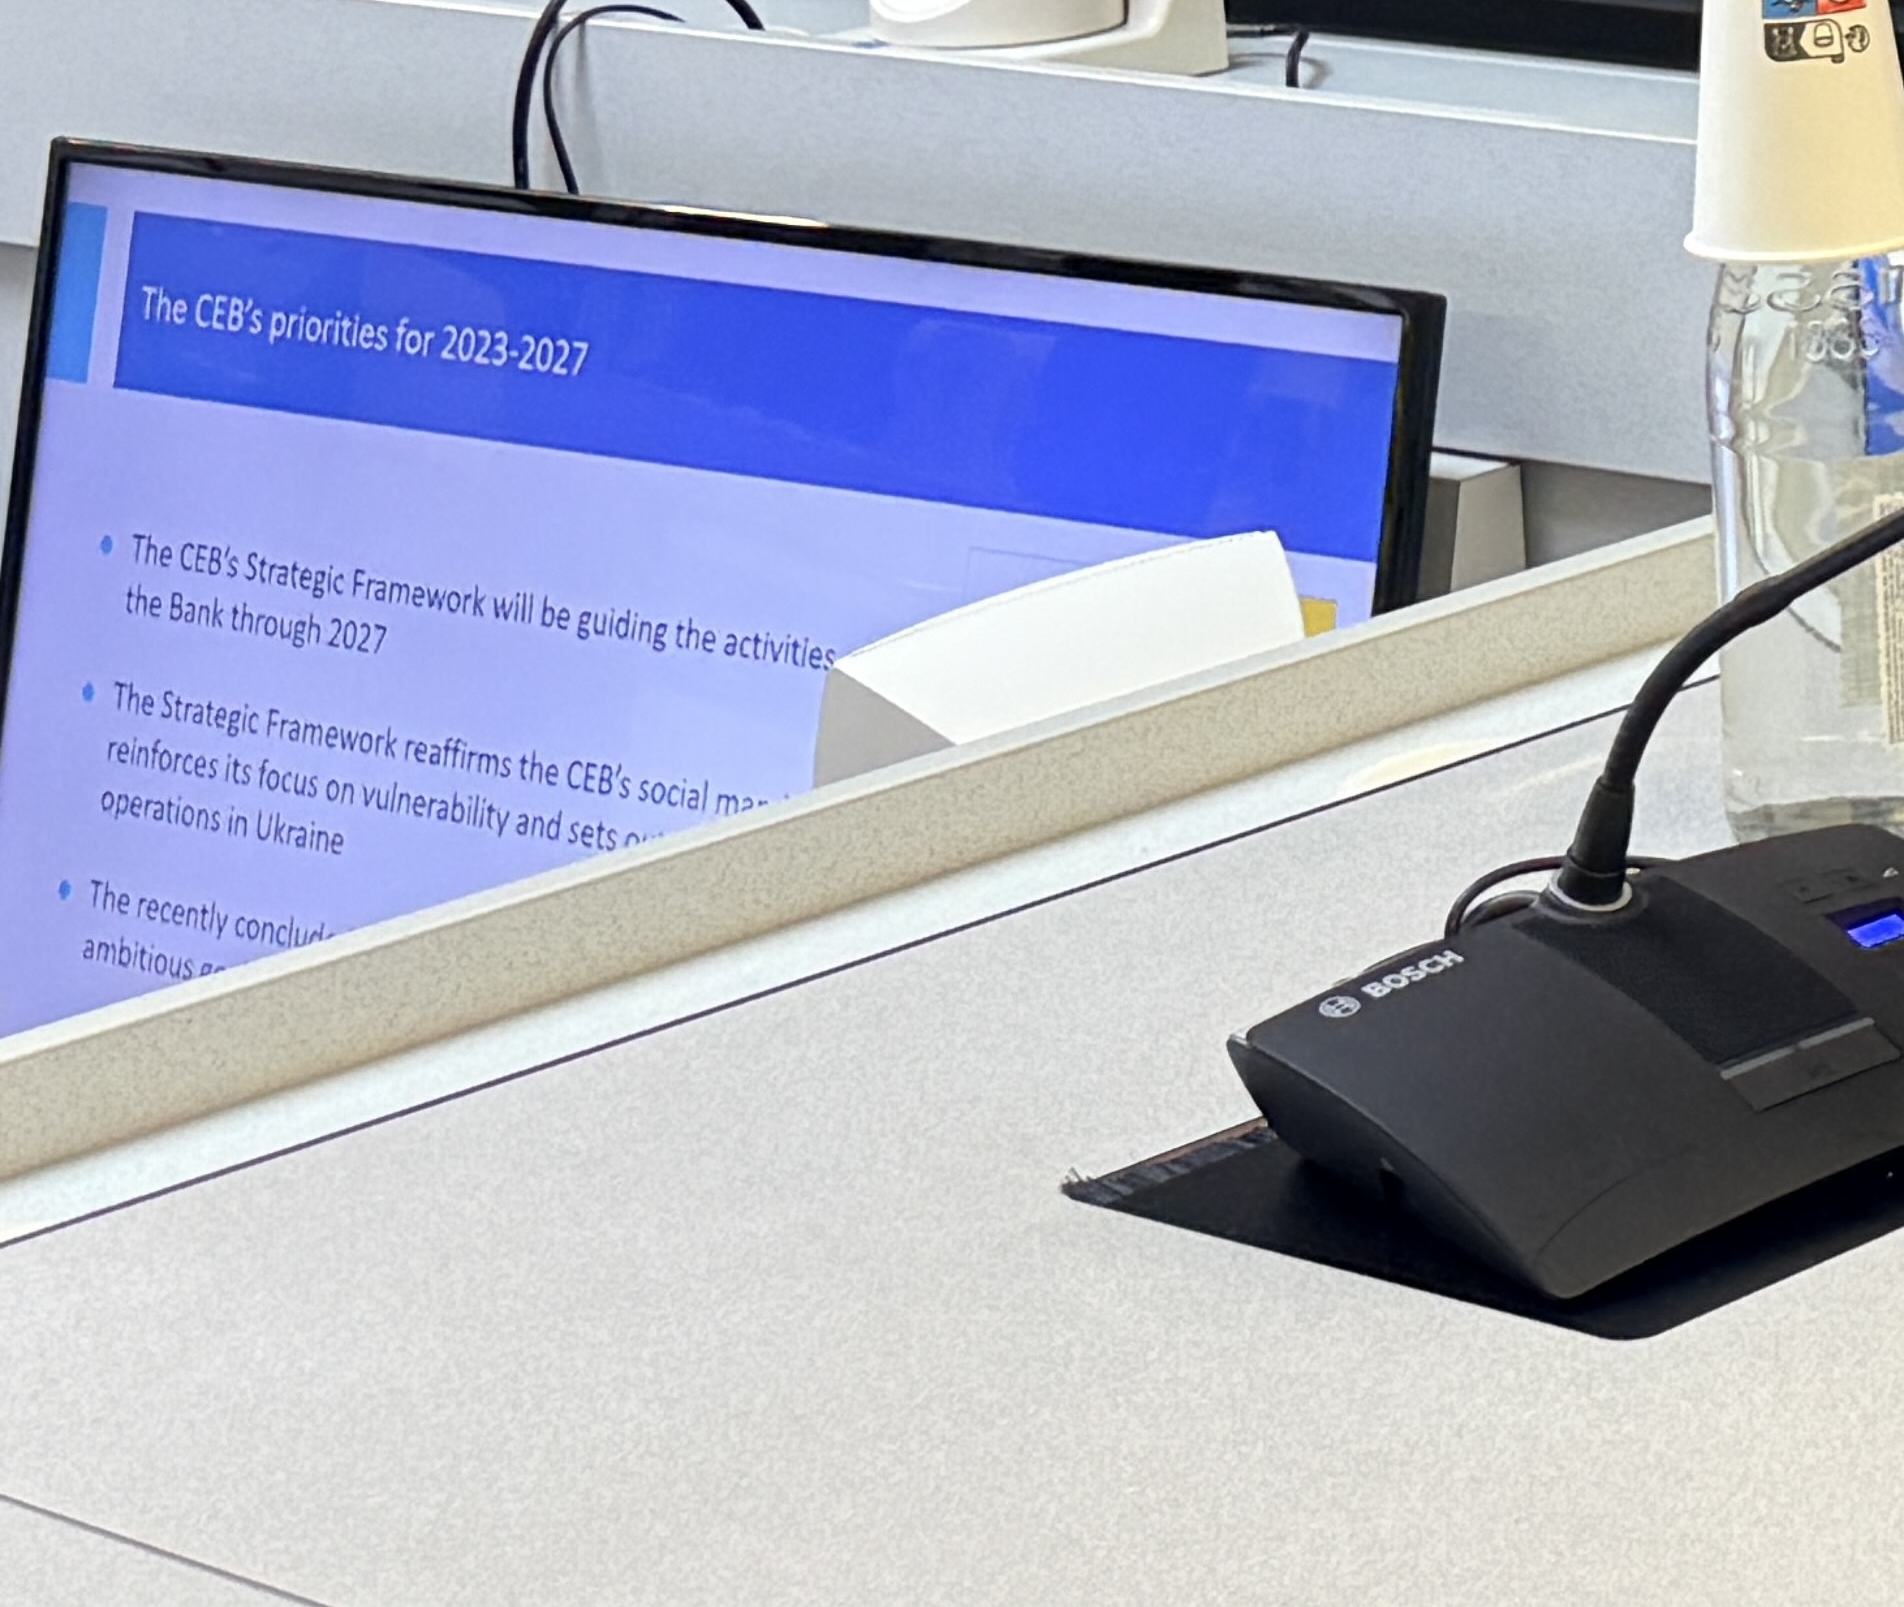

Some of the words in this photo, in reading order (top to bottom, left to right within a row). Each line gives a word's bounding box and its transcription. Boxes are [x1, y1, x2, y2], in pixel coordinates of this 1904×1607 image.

[142, 286, 187, 325] The
[269, 306, 388, 351] priorities
[396, 317, 434, 356] for
[441, 325, 589, 376] 2023-2027
[126, 585, 162, 617] the
[169, 592, 223, 628] Bank
[231, 603, 321, 648] through
[328, 618, 387, 654] 2027
[133, 534, 172, 567] The
[247, 552, 344, 599] Strategic
[352, 569, 485, 616] Framework
[494, 592, 533, 625] will
[541, 596, 570, 630] be
[577, 608, 667, 652] guiding
[675, 618, 716, 653] the
[724, 631, 835, 671] activities
[114, 681, 154, 716] The
[161, 690, 259, 737] Strategic
[266, 709, 398, 759] Framework
[404, 737, 512, 779] reaffirms
[519, 750, 559, 787] the
[638, 778, 709, 814] social
[100, 790, 220, 832] operations
[227, 806, 248, 837] in
[256, 809, 344, 855] Ukraine
[108, 737, 218, 779] reinforces
[225, 753, 251, 786] its
[258, 759, 318, 797] focus
[326, 779, 355, 805] on
[362, 781, 508, 837] vulnerability
[516, 810, 562, 841] and
[567, 820, 617, 851] sets
[90, 879, 130, 915] The
[137, 896, 228, 939] recently
[235, 916, 335, 948] conclud
[82, 937, 193, 981] ambitious
[1361, 950, 1465, 998] BOSCH
